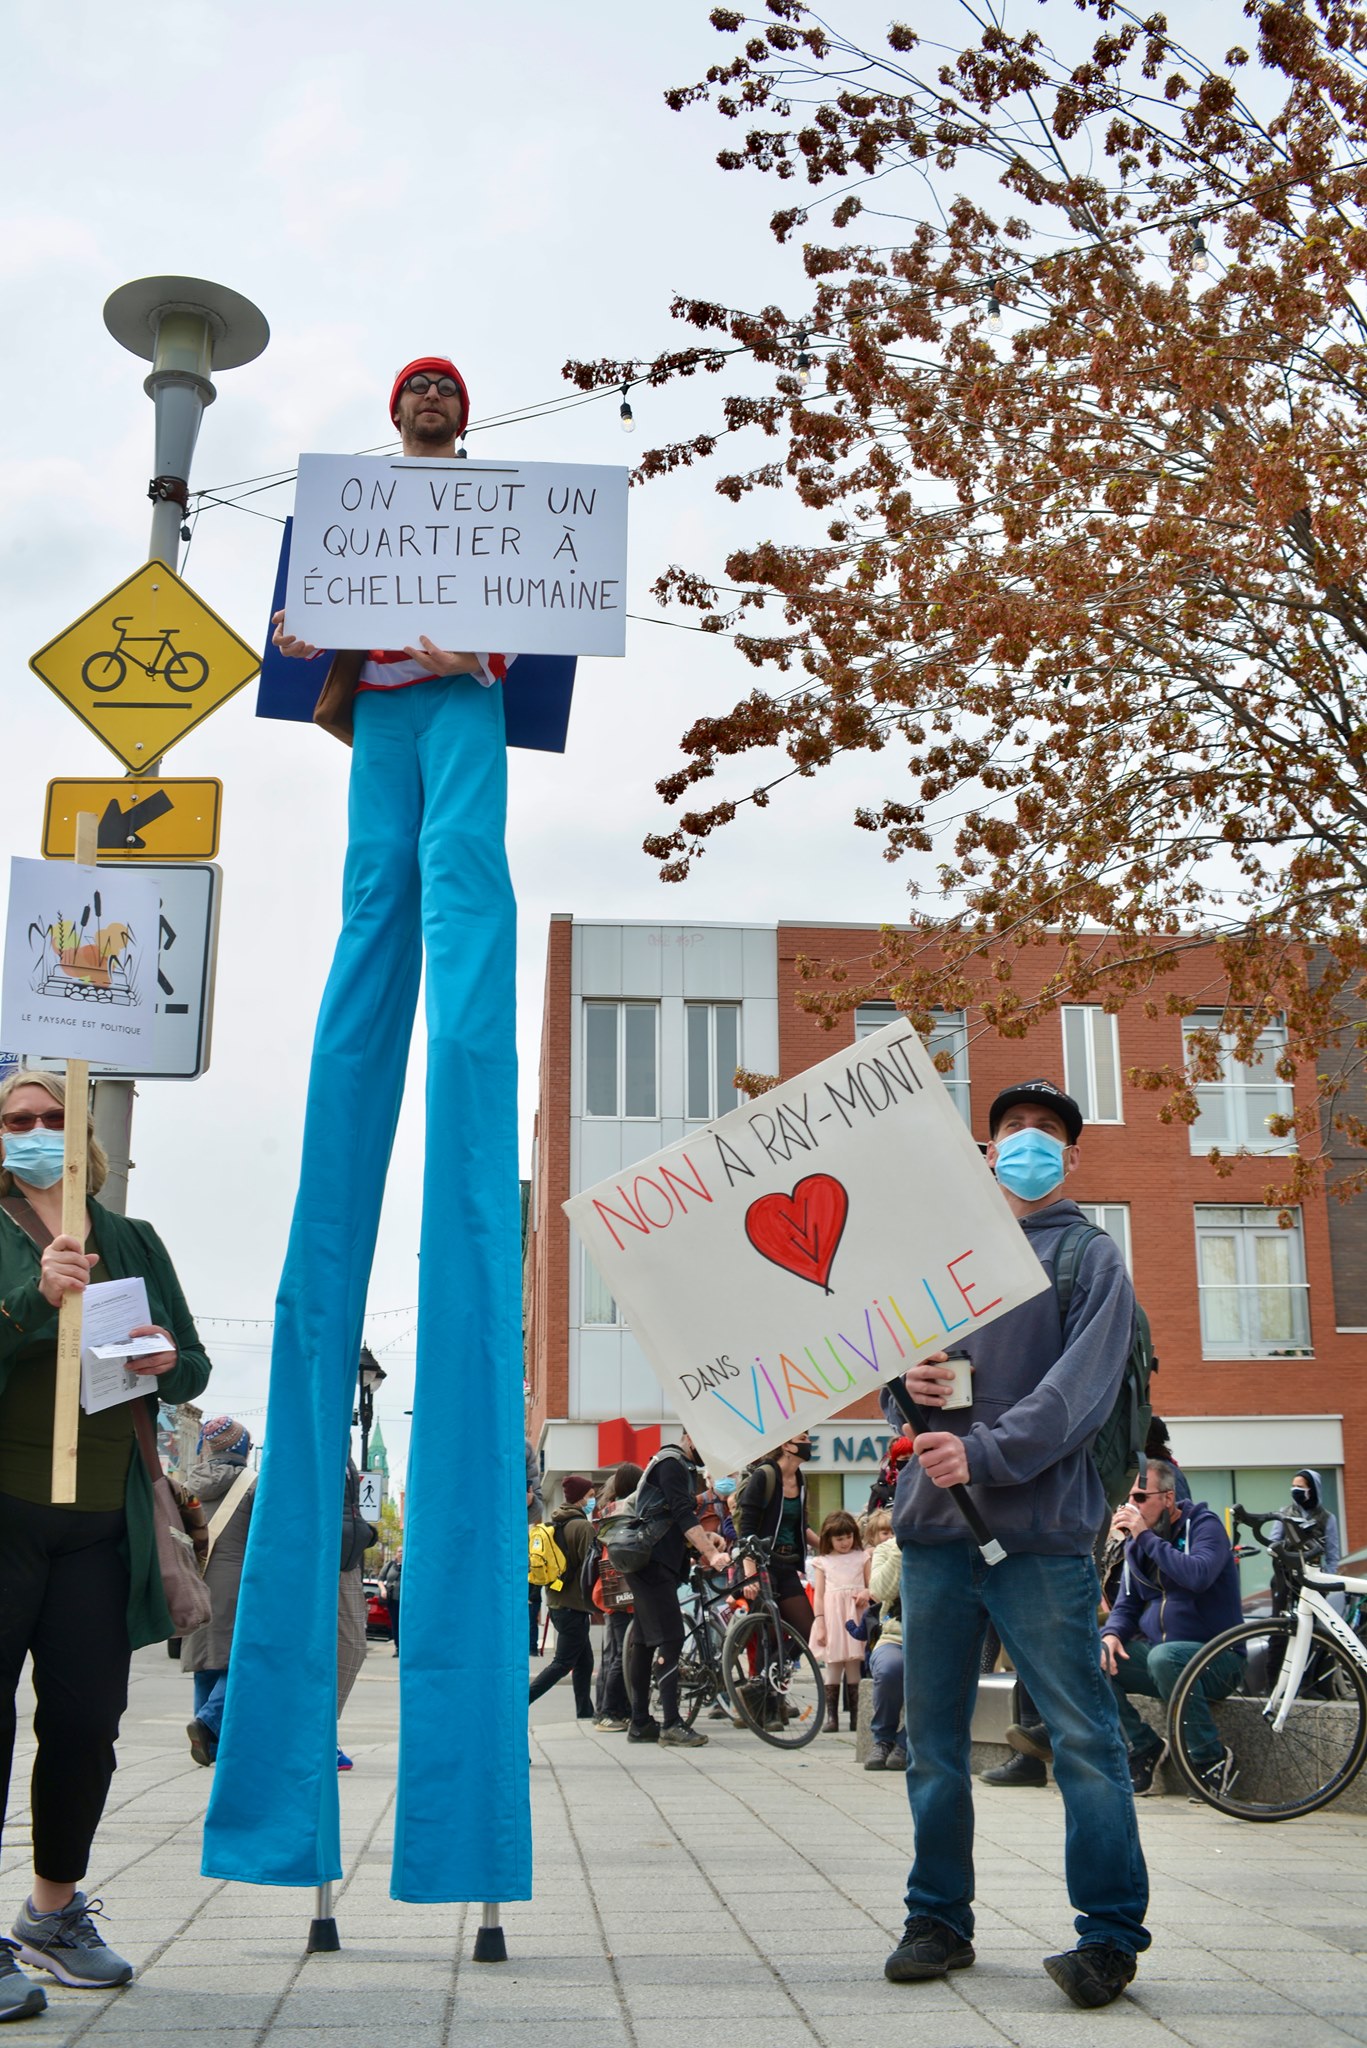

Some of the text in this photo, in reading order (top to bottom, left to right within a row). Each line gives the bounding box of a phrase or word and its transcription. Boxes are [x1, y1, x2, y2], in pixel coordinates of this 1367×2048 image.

[340, 477, 597, 515] ON VEUT UN
[322, 524, 579, 562] QUARTIER À
[303, 566, 458, 606] ÉCHELLE
[21, 1014, 142, 1035] LE PAYSAGE EST POLITIQUE
[591, 1034, 924, 1251] NON À RAY-MONT
[678, 1354, 741, 1402] DANS
